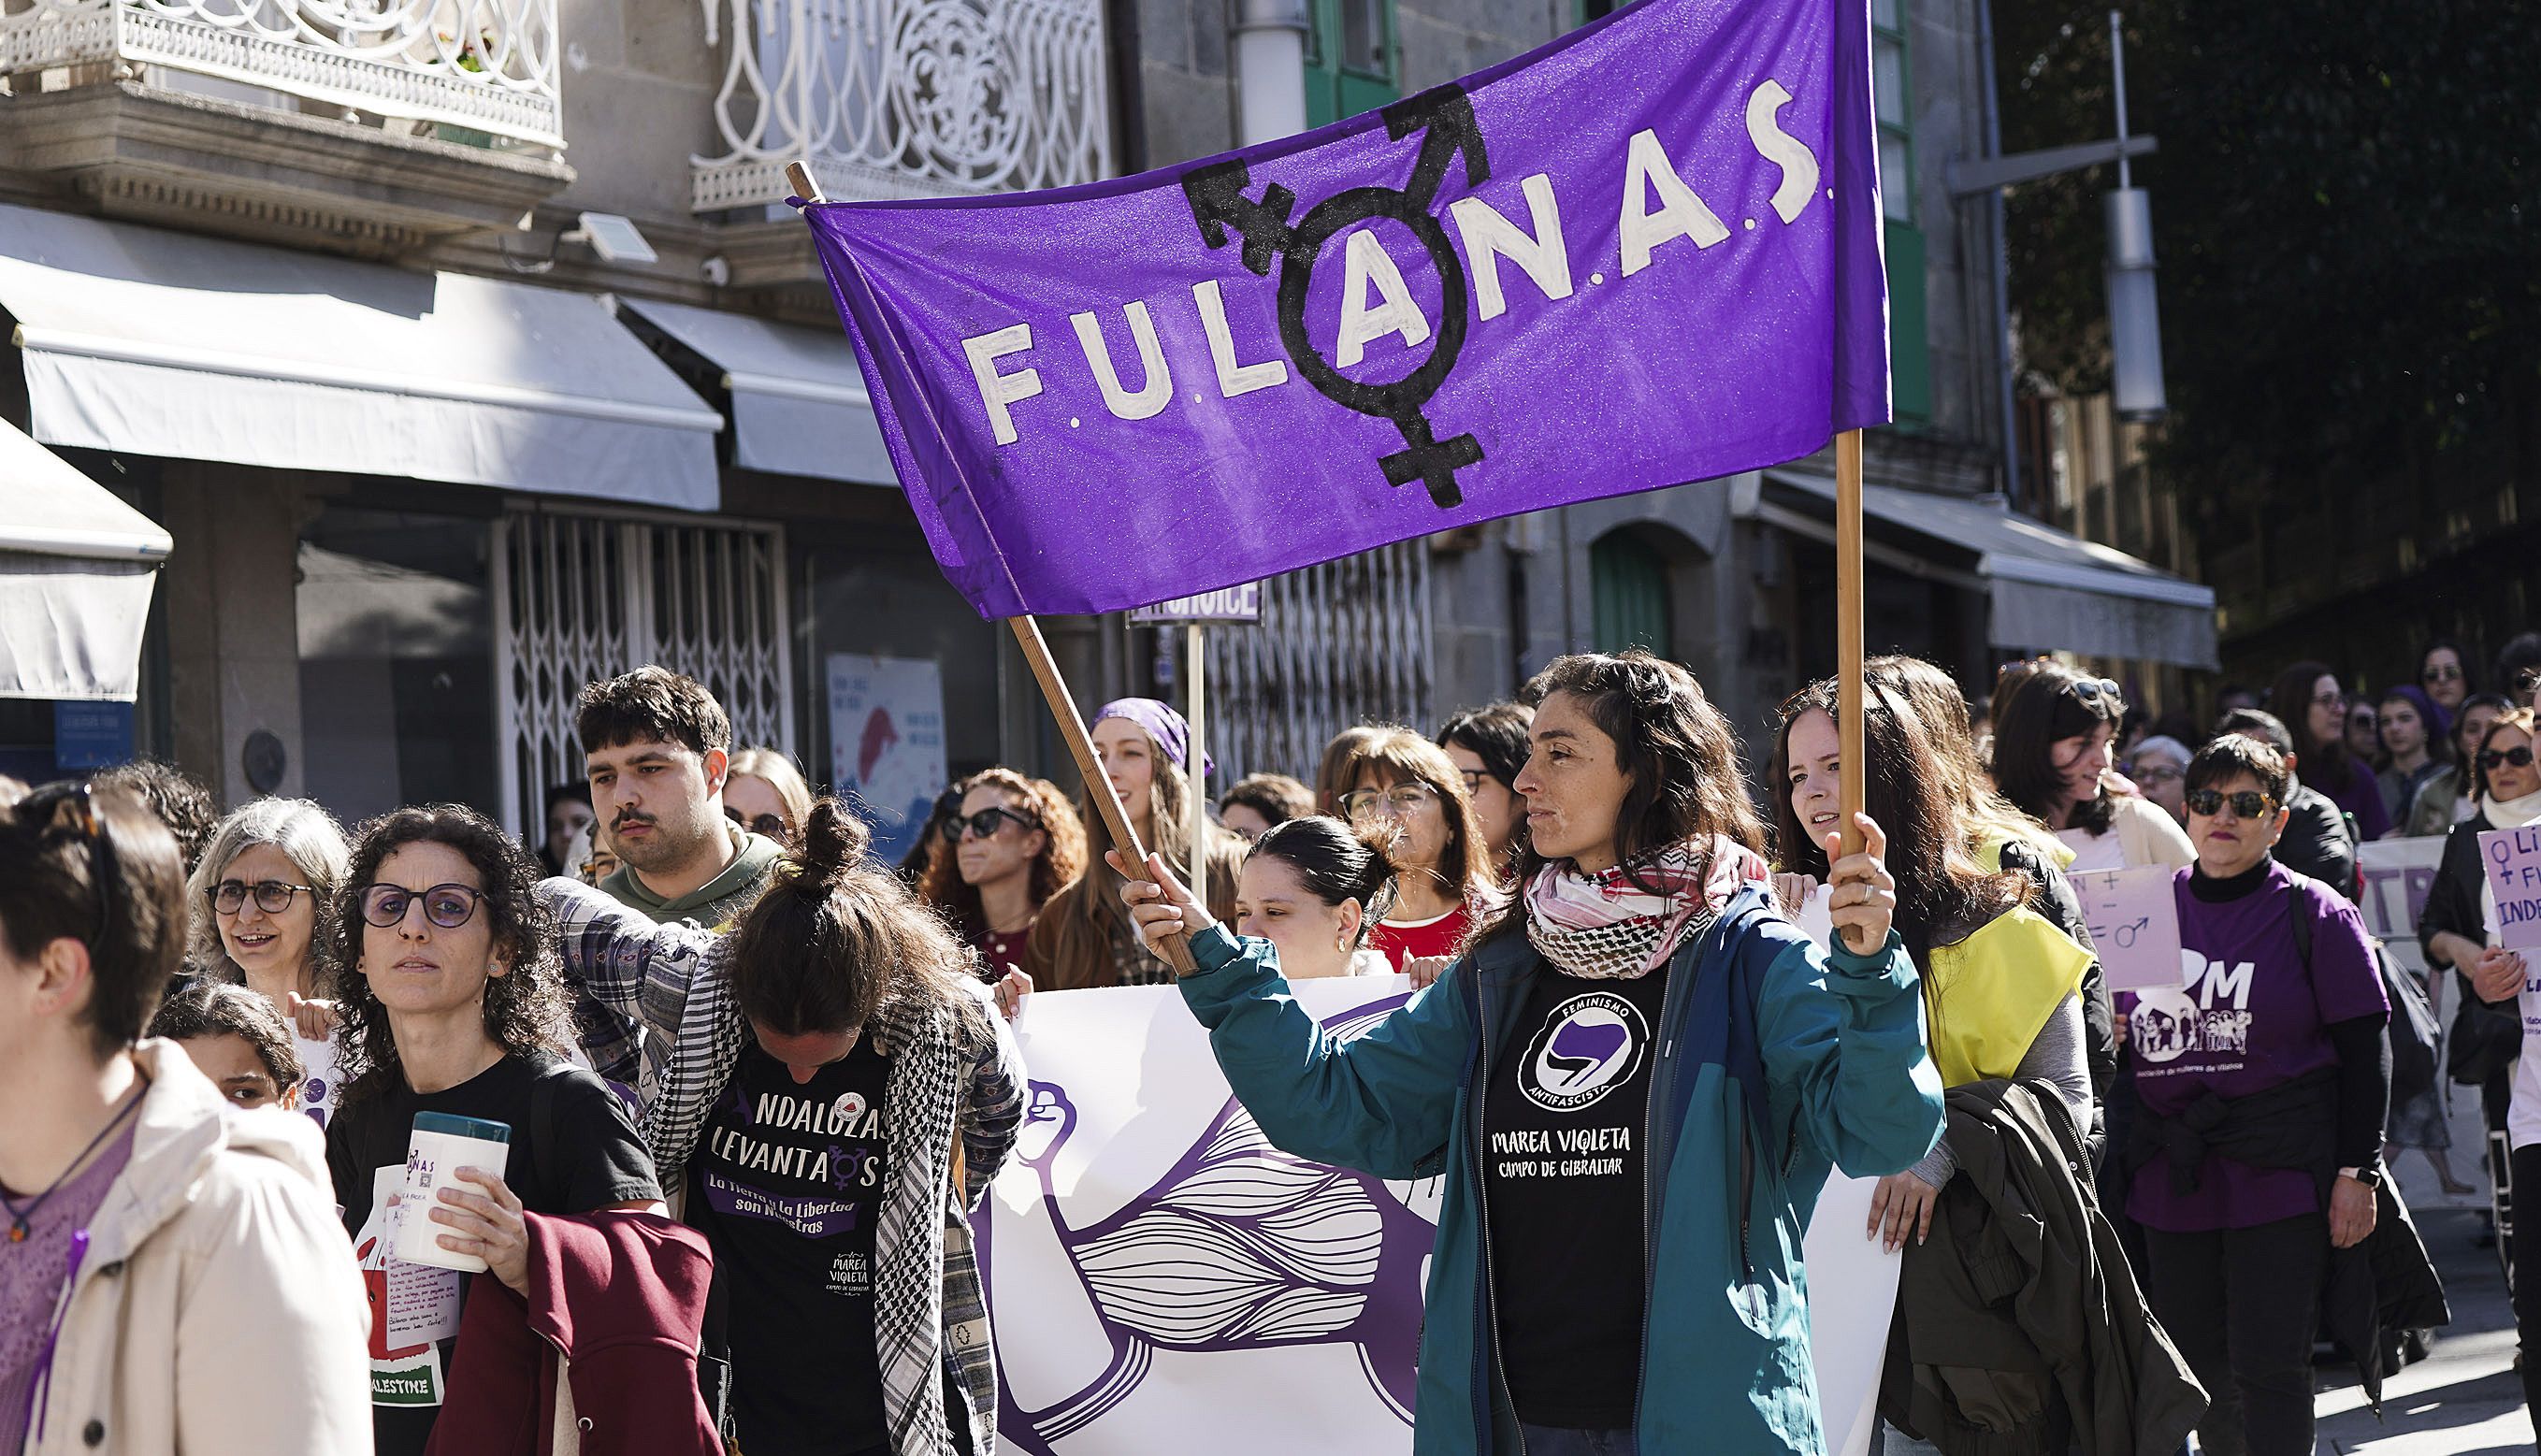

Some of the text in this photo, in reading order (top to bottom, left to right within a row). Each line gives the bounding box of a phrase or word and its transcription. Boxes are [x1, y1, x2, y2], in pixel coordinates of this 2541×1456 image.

[1561, 997, 1630, 1018] FEMINISMO
[1528, 1085, 1610, 1107] ANTIFASCISTA
[1492, 1127, 1631, 1156] MAREA VIOLETA
[1498, 1158, 1623, 1178] CAMPO DE GIBRALTAR
[709, 1174, 725, 1189] La
[729, 1180, 767, 1204] Tierra
[796, 1201, 855, 1218] Libertad
[735, 1198, 823, 1234] son Nuestras
[832, 1258, 867, 1271] MAREA
[829, 1270, 868, 1285] VIOLETA
[371, 1378, 429, 1394] ALESTINE
